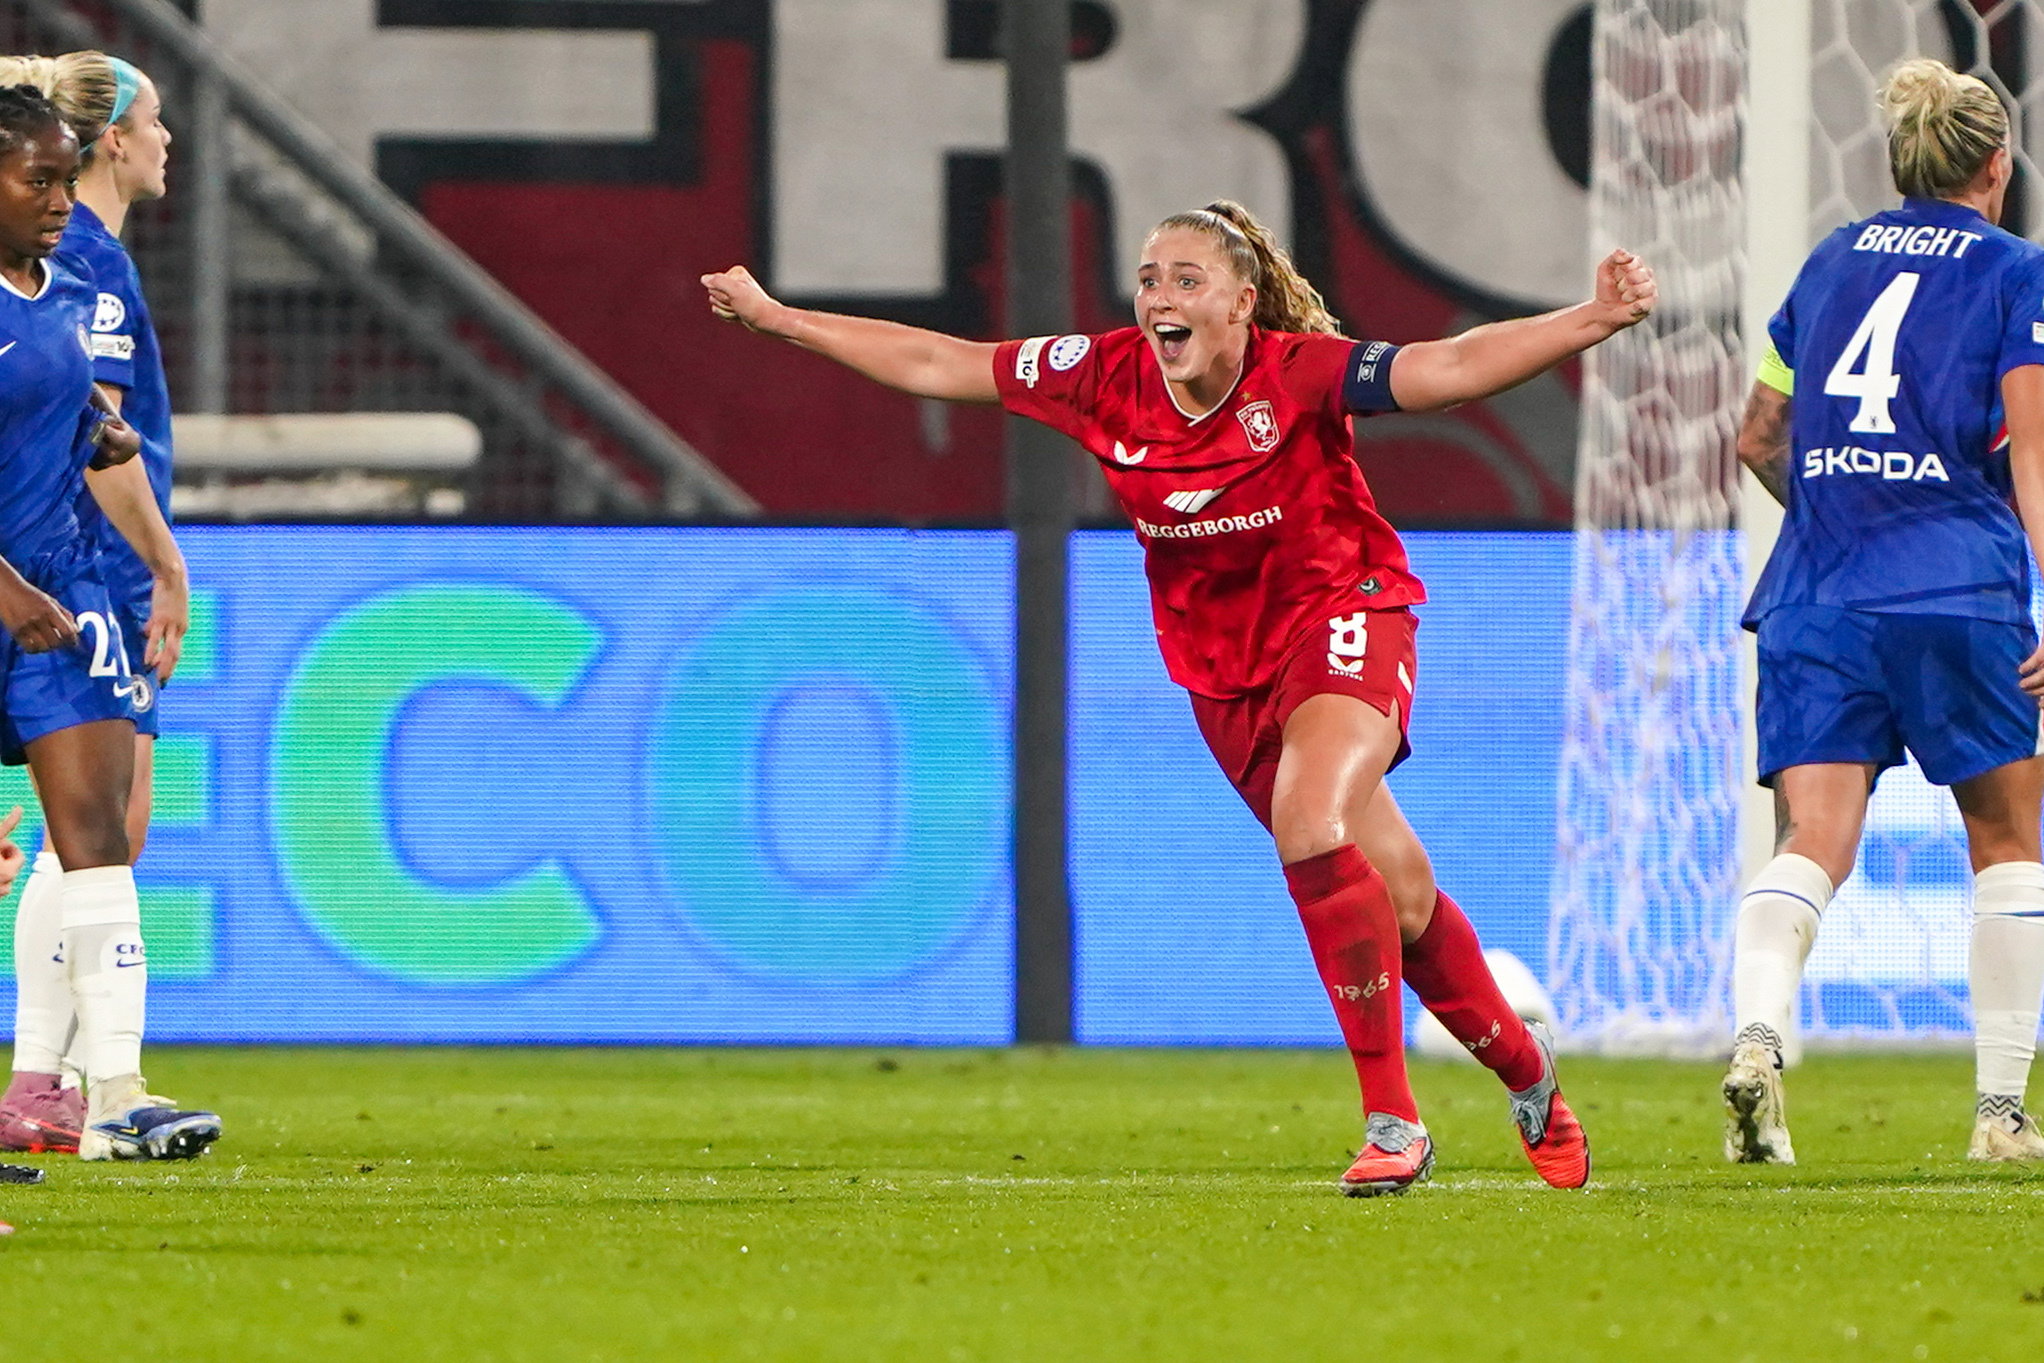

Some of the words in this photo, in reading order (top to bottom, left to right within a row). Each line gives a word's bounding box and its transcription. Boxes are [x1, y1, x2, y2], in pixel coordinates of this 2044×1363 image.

[1853, 223, 1982, 258] BRIGHT
[1824, 271, 1920, 434] 4
[1136, 505, 1283, 539] REGGEBORGH
[1328, 612, 1367, 657] 8
[1334, 972, 1389, 1000] 1965
